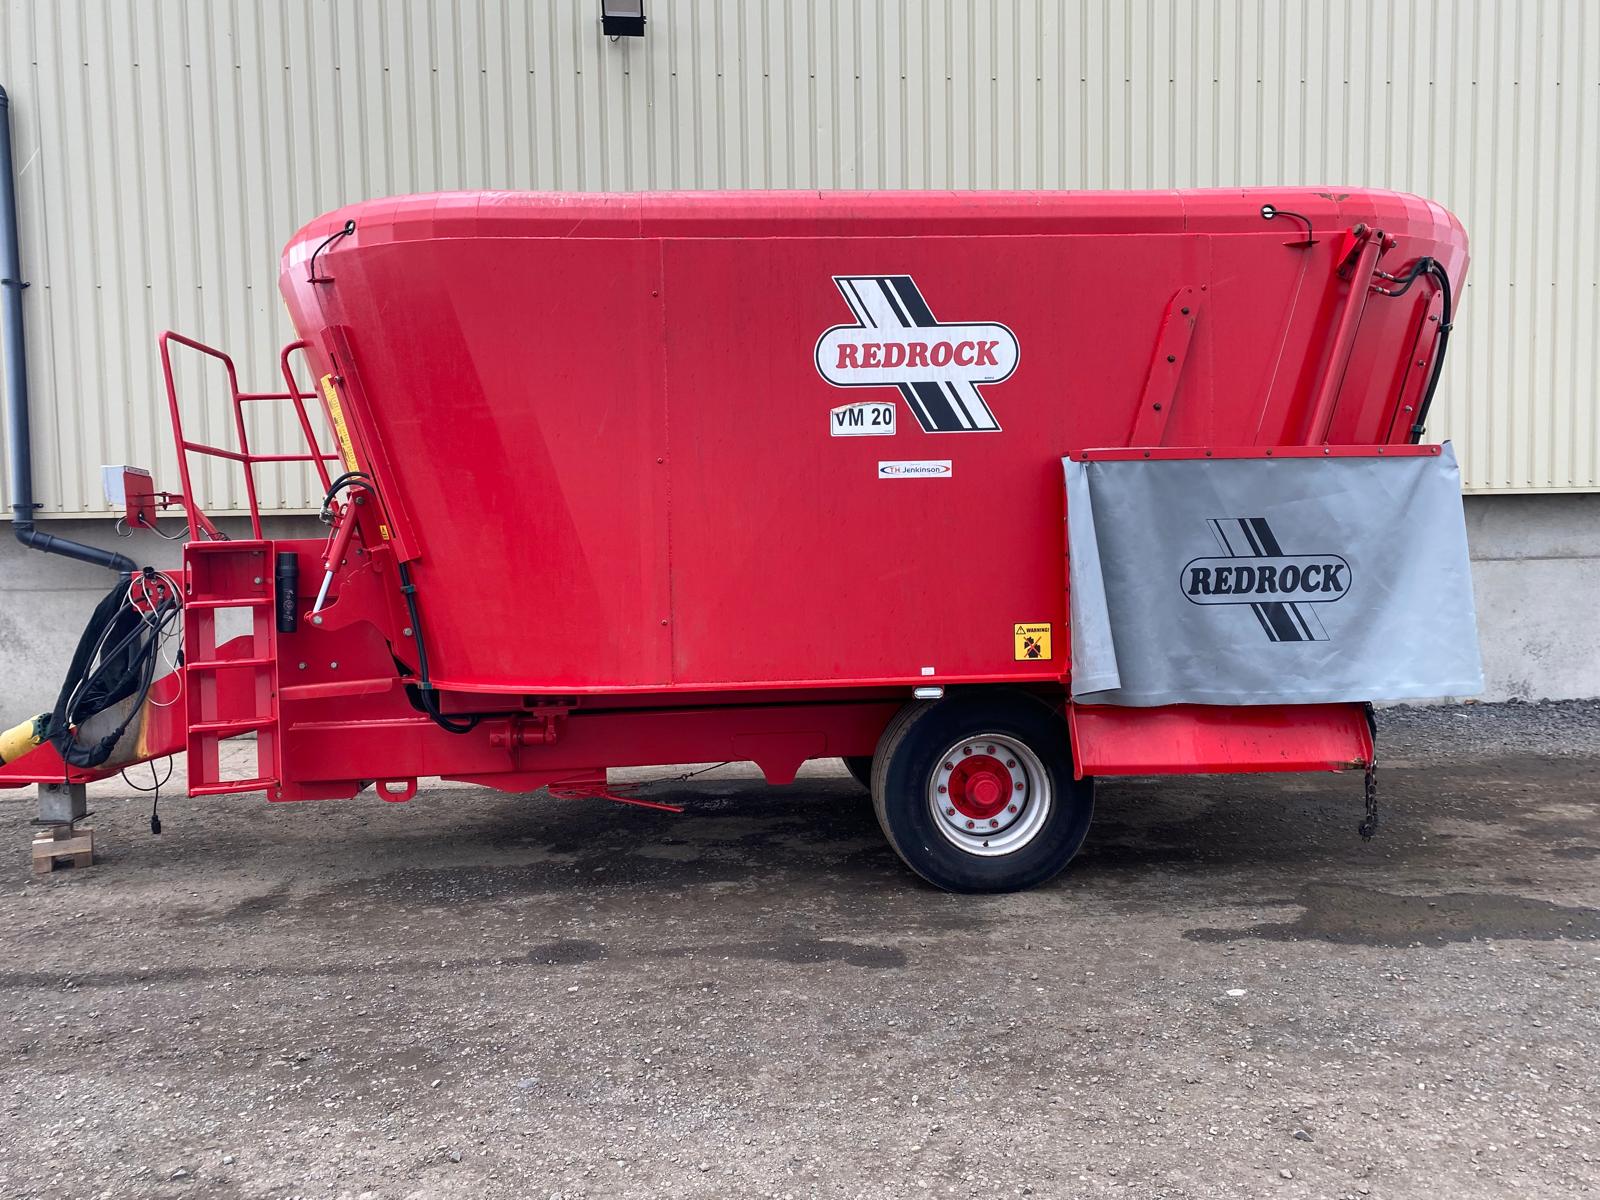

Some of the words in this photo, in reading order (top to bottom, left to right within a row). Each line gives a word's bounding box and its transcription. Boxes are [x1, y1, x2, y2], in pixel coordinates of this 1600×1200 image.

[835, 340, 999, 369] REDROCK
[835, 408, 864, 427] VM
[871, 407, 892, 426] 20
[890, 466, 901, 474] TH
[903, 465, 941, 474] Jenkinson
[1187, 564, 1345, 596] REDROCK
